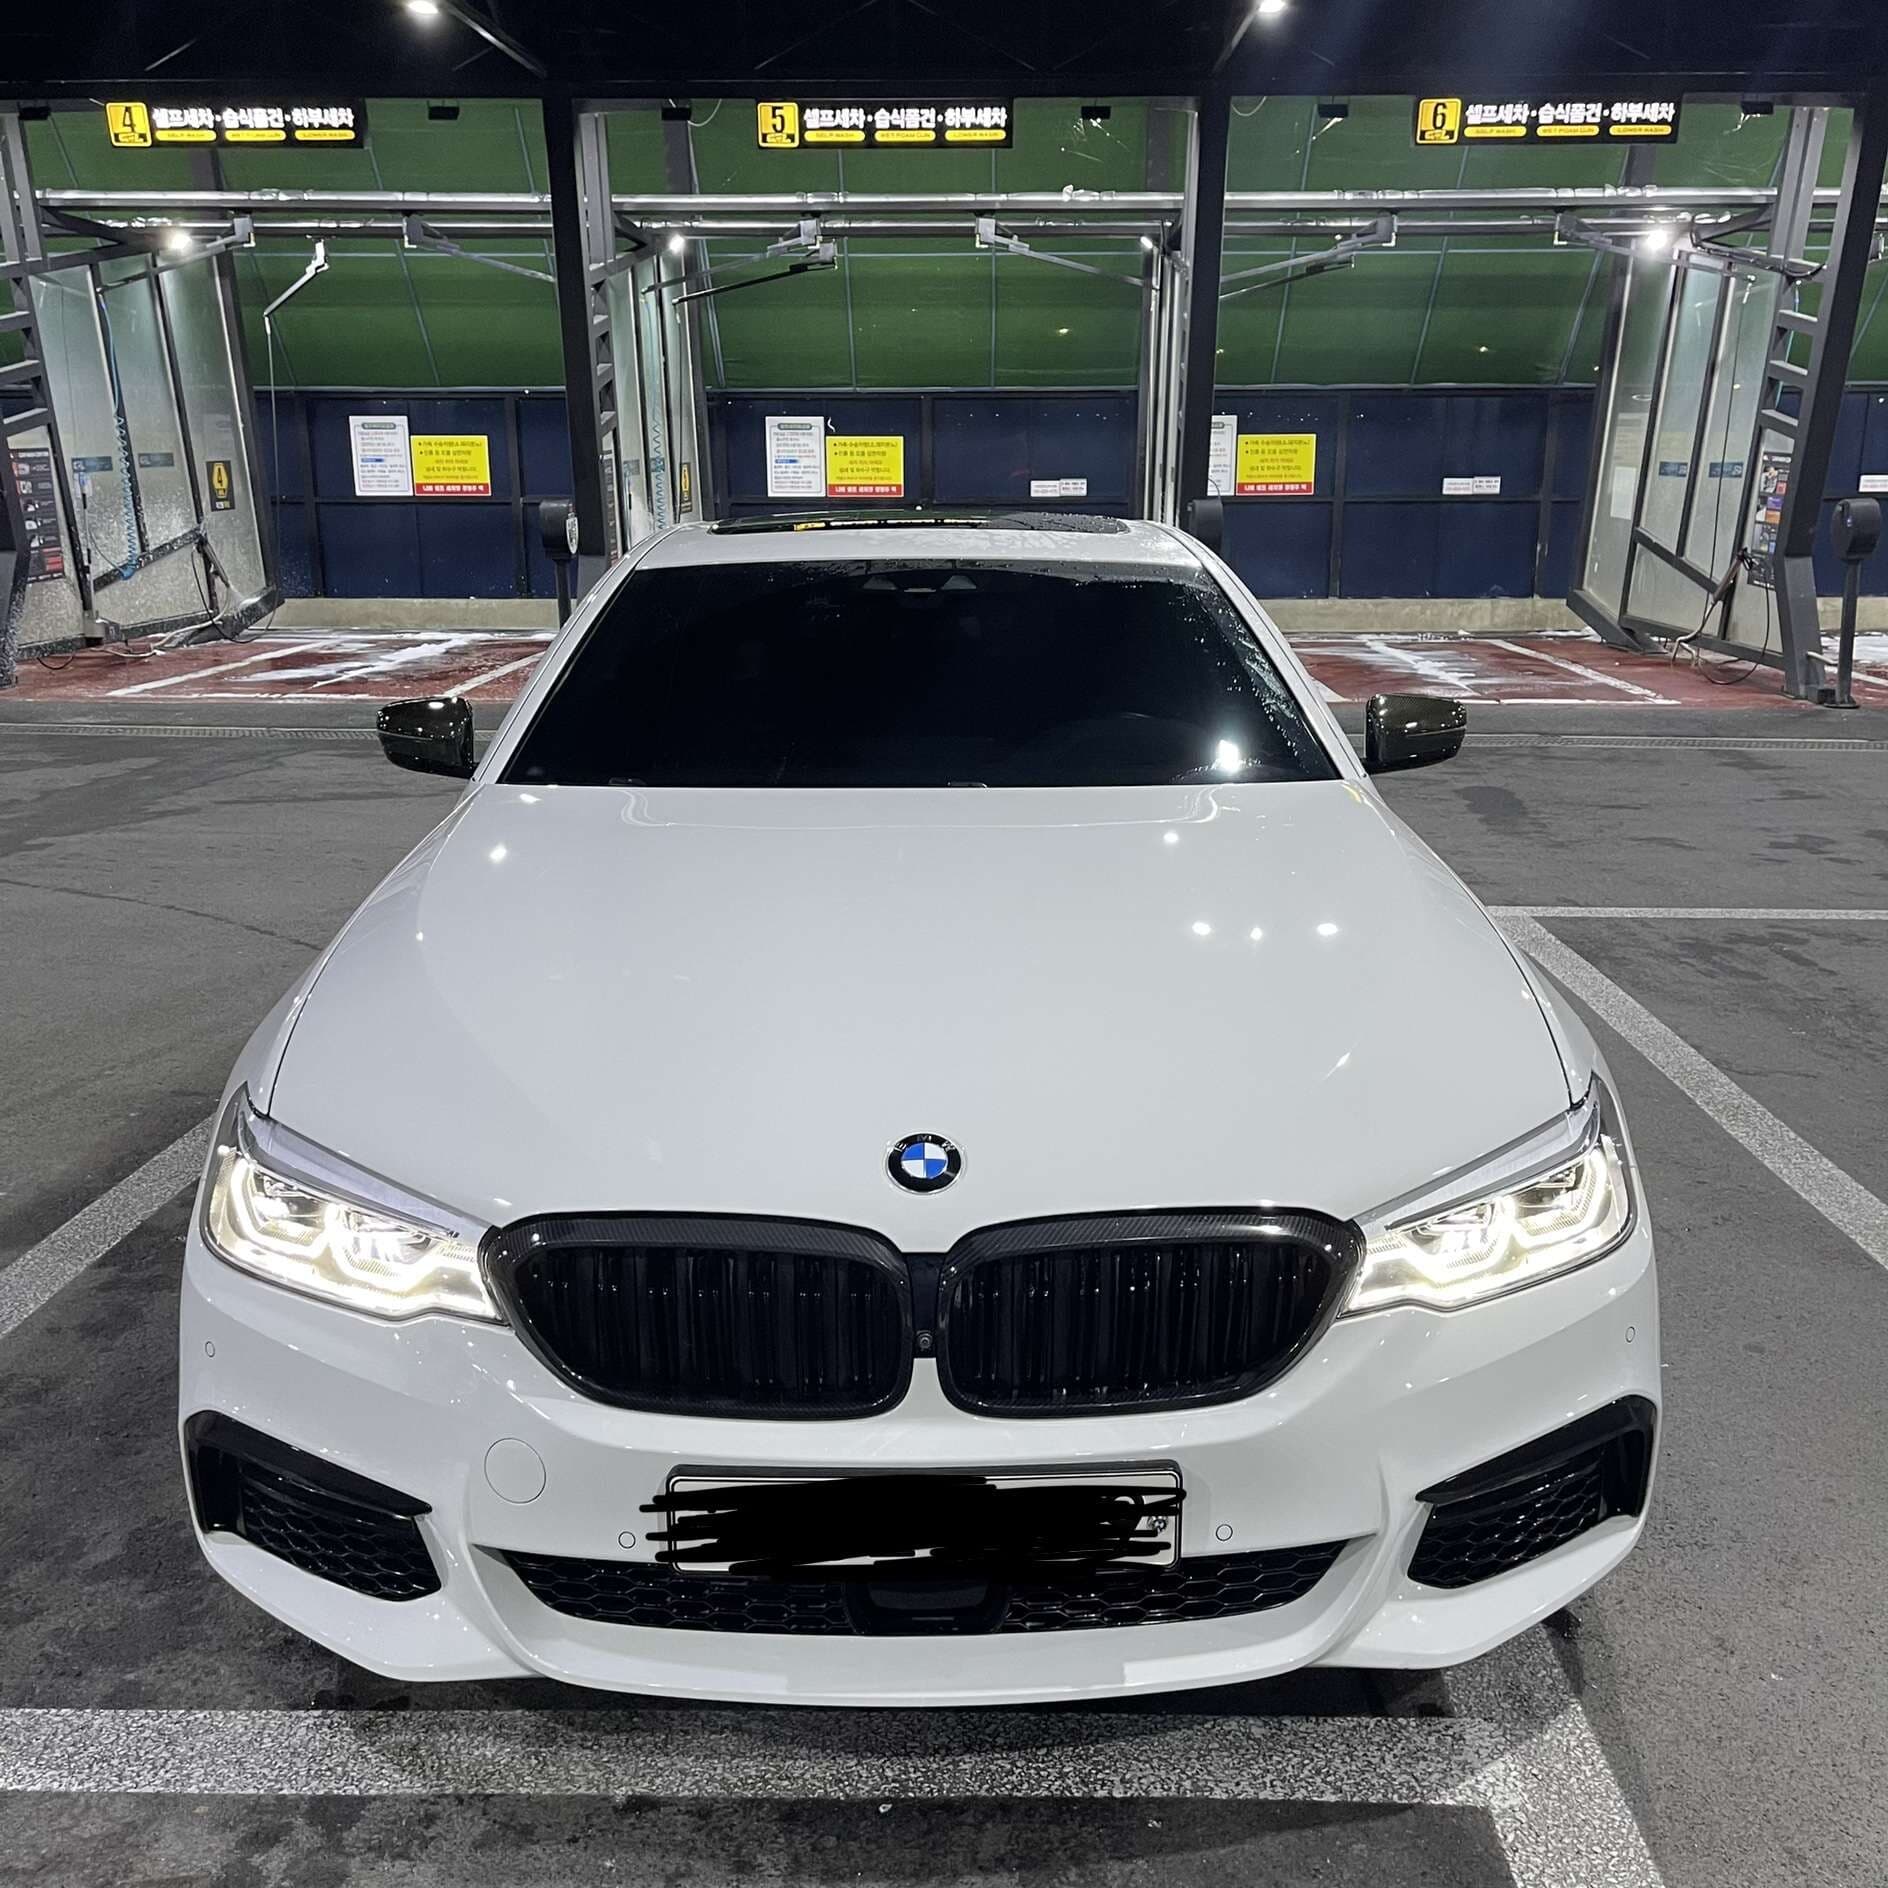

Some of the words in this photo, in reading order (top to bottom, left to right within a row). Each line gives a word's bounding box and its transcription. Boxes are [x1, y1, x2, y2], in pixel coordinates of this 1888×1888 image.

[123, 106, 137, 134] 4
[771, 105, 785, 133] 5
[803, 107, 866, 129] 셀프세차
[944, 107, 1008, 128] 하부세차
[1432, 102, 1446, 130] 6
[1466, 103, 1529, 125] 셀프세차
[1610, 101, 1676, 123] 하부세차
[894, 1135, 956, 1152] BMW
